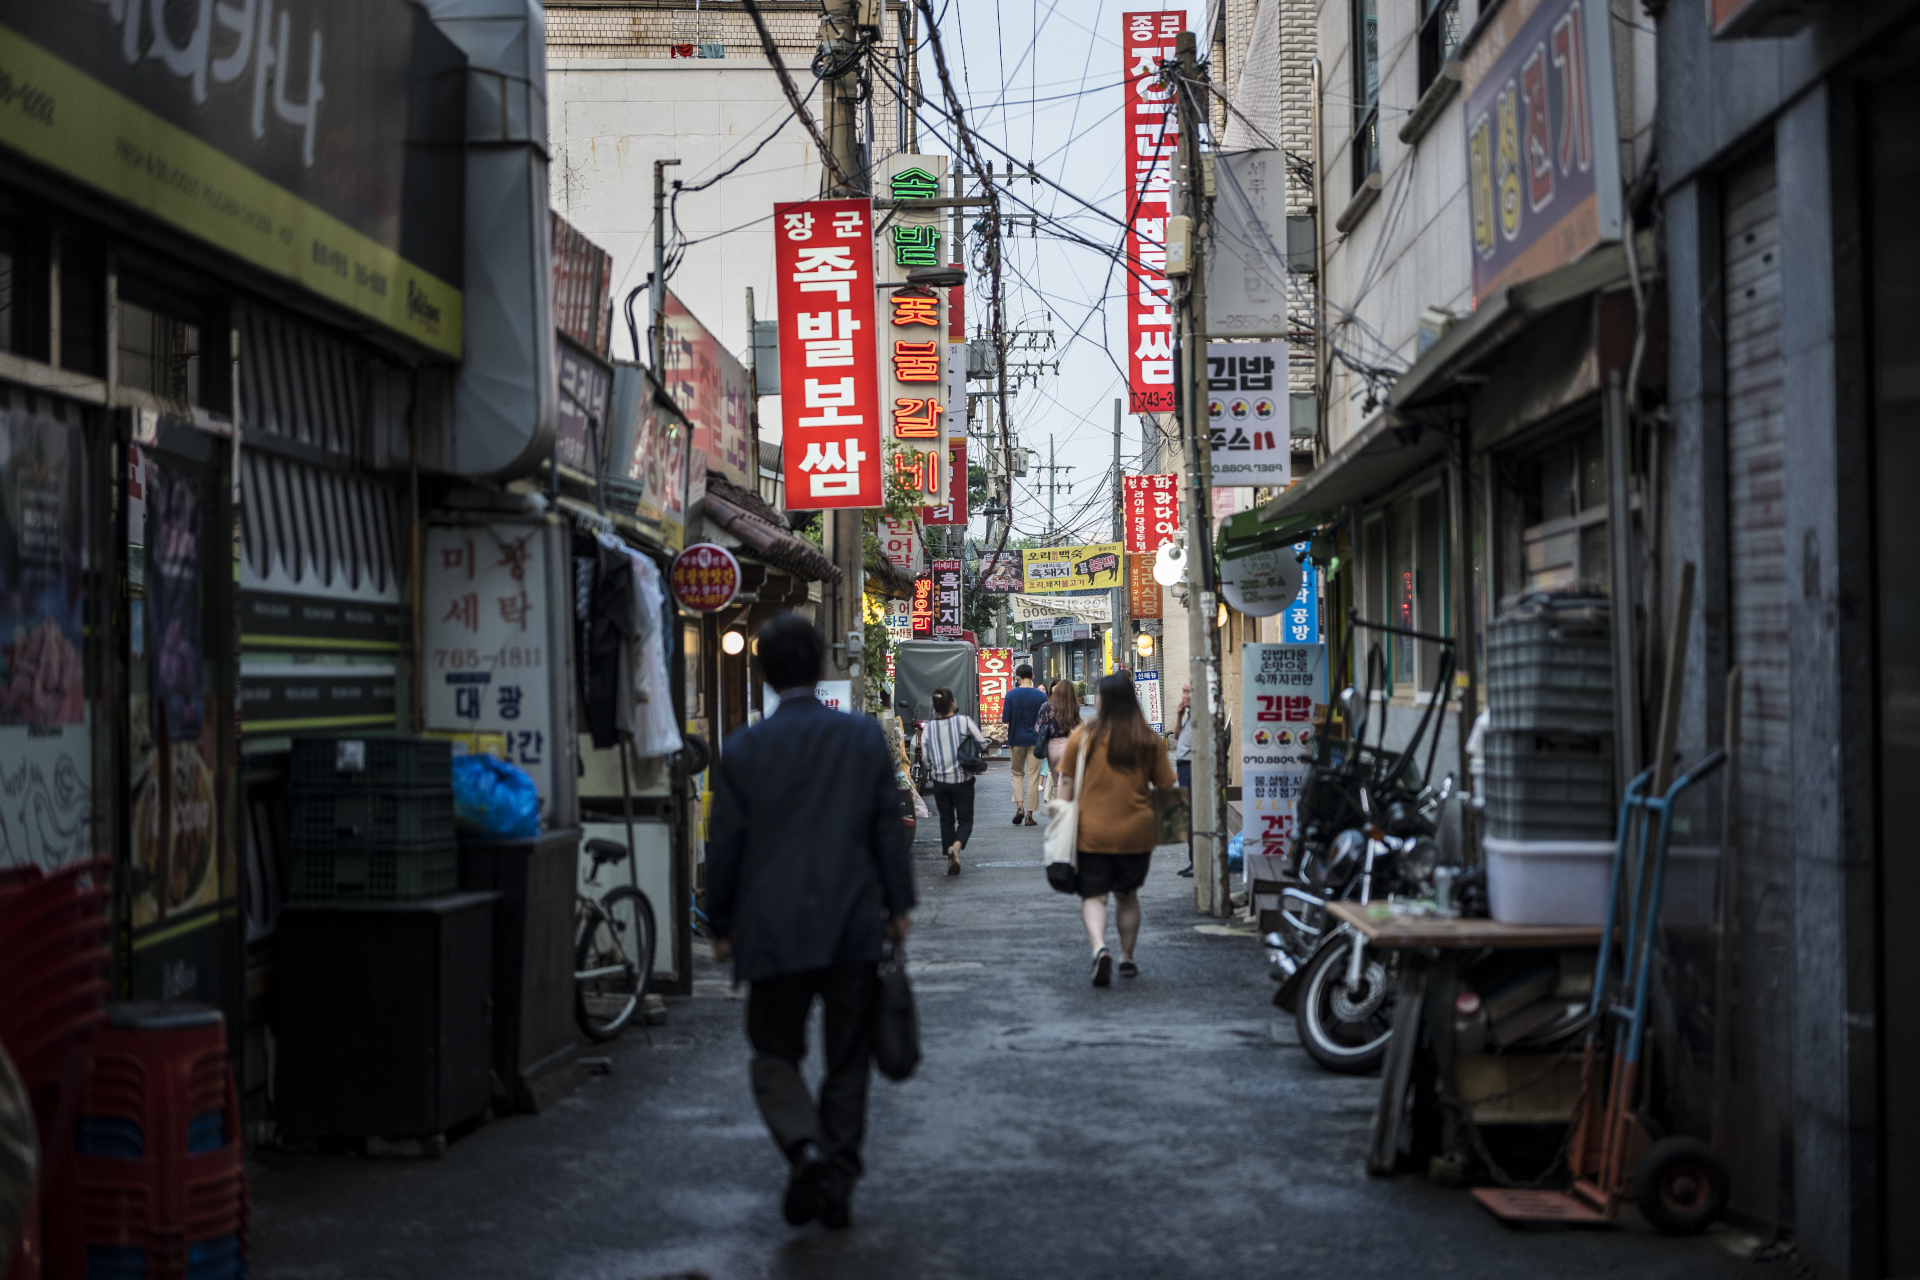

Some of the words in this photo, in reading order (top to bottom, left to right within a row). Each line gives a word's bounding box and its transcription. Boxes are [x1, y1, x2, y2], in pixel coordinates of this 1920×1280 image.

[1130, 15, 1179, 41] 종로
[783, 211, 863, 241] 장군
[793, 246, 867, 498] 족발보쌈
[1208, 356, 1275, 391] 김밥
[891, 287, 944, 494] 숯불갈비
[1130, 391, 1175, 408] T.743-3
[1134, 490, 1145, 515] 라이브
[1030, 567, 1070, 578] 흑돼지
[939, 572, 960, 625] 흑돼지
[1261, 649, 1308, 661] 집밥다운
[1261, 661, 1308, 673] 손맛으로
[979, 658, 1010, 699] 오리
[1254, 673, 1314, 685] 속까지편한
[456, 685, 523, 720] 대광
[980, 703, 1004, 714] 막국
[1257, 695, 1312, 722] 김밥
